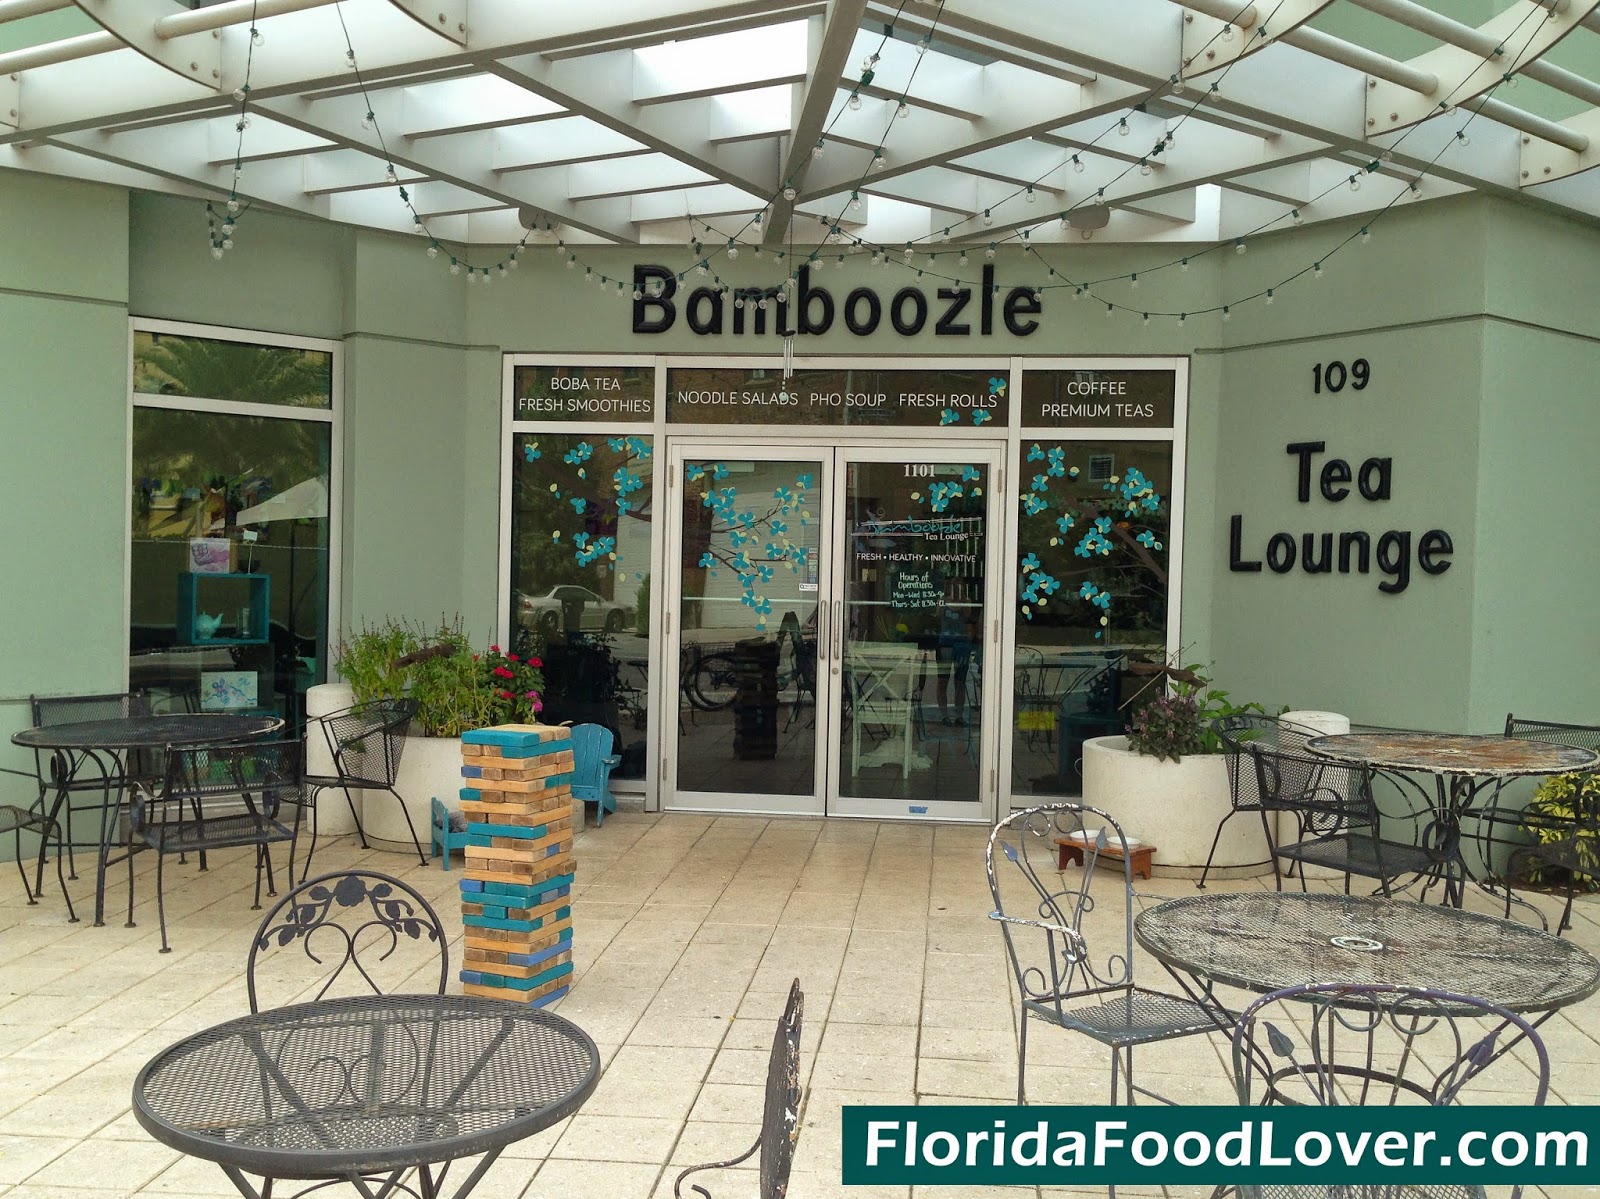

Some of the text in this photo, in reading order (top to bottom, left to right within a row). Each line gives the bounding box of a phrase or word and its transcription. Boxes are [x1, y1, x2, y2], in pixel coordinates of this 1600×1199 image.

[633, 264, 1042, 336] Bamboozle
[1312, 358, 1370, 394] 109
[551, 377, 621, 391] BOBA TEA
[1067, 381, 1127, 395] COFFEE
[519, 398, 651, 413] FRESH SMOOTHIES
[677, 391, 799, 406] NOODLE SALADS
[810, 393, 887, 407] PHO SOUP
[899, 393, 998, 408] FRESH ROLLS
[1041, 403, 1154, 418] PREMIUM TEAS
[904, 464, 936, 477] 1101
[1286, 441, 1392, 502] Tea
[924, 532, 969, 542] Tea Lounge
[856, 553, 976, 563] FRESH HEALTHY INNOVATIVE
[1229, 514, 1454, 594] Lounge
[899, 572, 930, 582] Hours of
